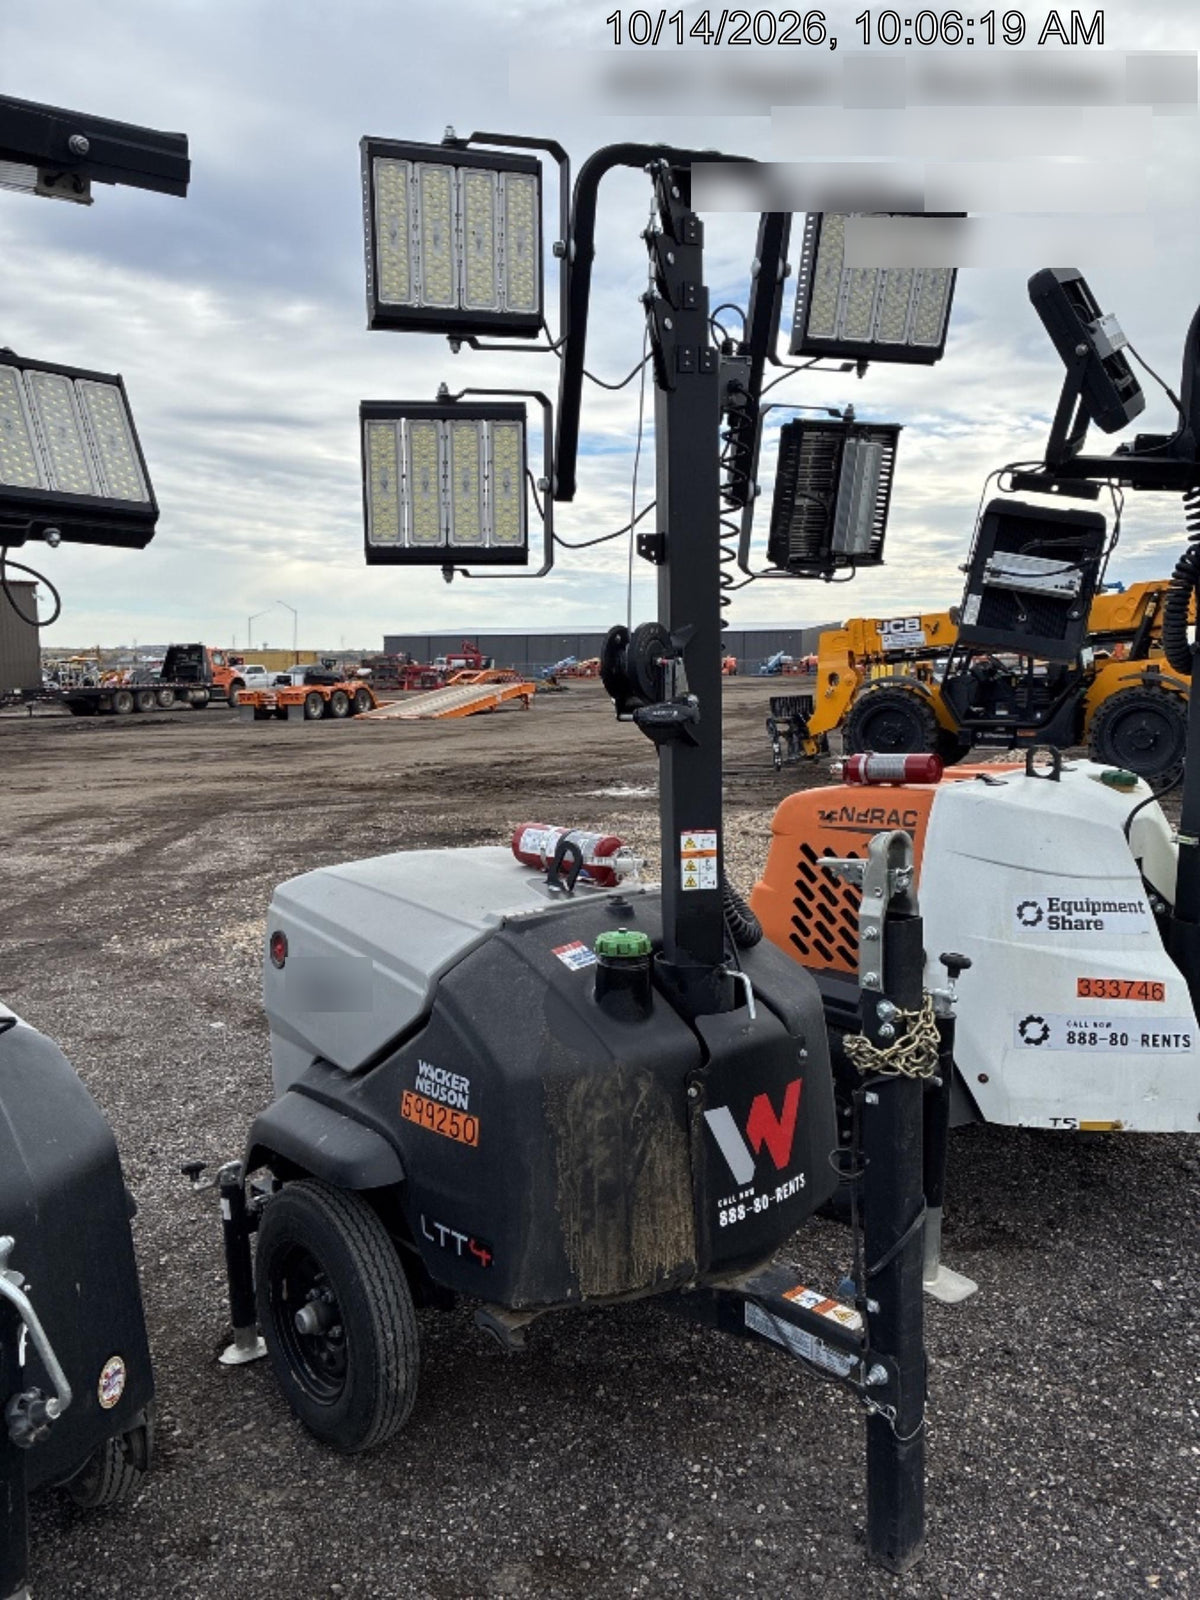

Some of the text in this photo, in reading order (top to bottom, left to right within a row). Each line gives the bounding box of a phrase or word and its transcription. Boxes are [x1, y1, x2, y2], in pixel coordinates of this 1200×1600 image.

[876, 618, 920, 634] JCB
[1047, 897, 1145, 916] Equipment
[1047, 915, 1104, 931] Share
[1078, 978, 1164, 1001] 333746
[1066, 1020, 1112, 1029] CALL NOW
[418, 1059, 470, 1094] WACKER
[415, 1075, 470, 1111] NEUSON
[403, 1092, 476, 1144] 599250
[420, 1213, 493, 1268] LTT4
